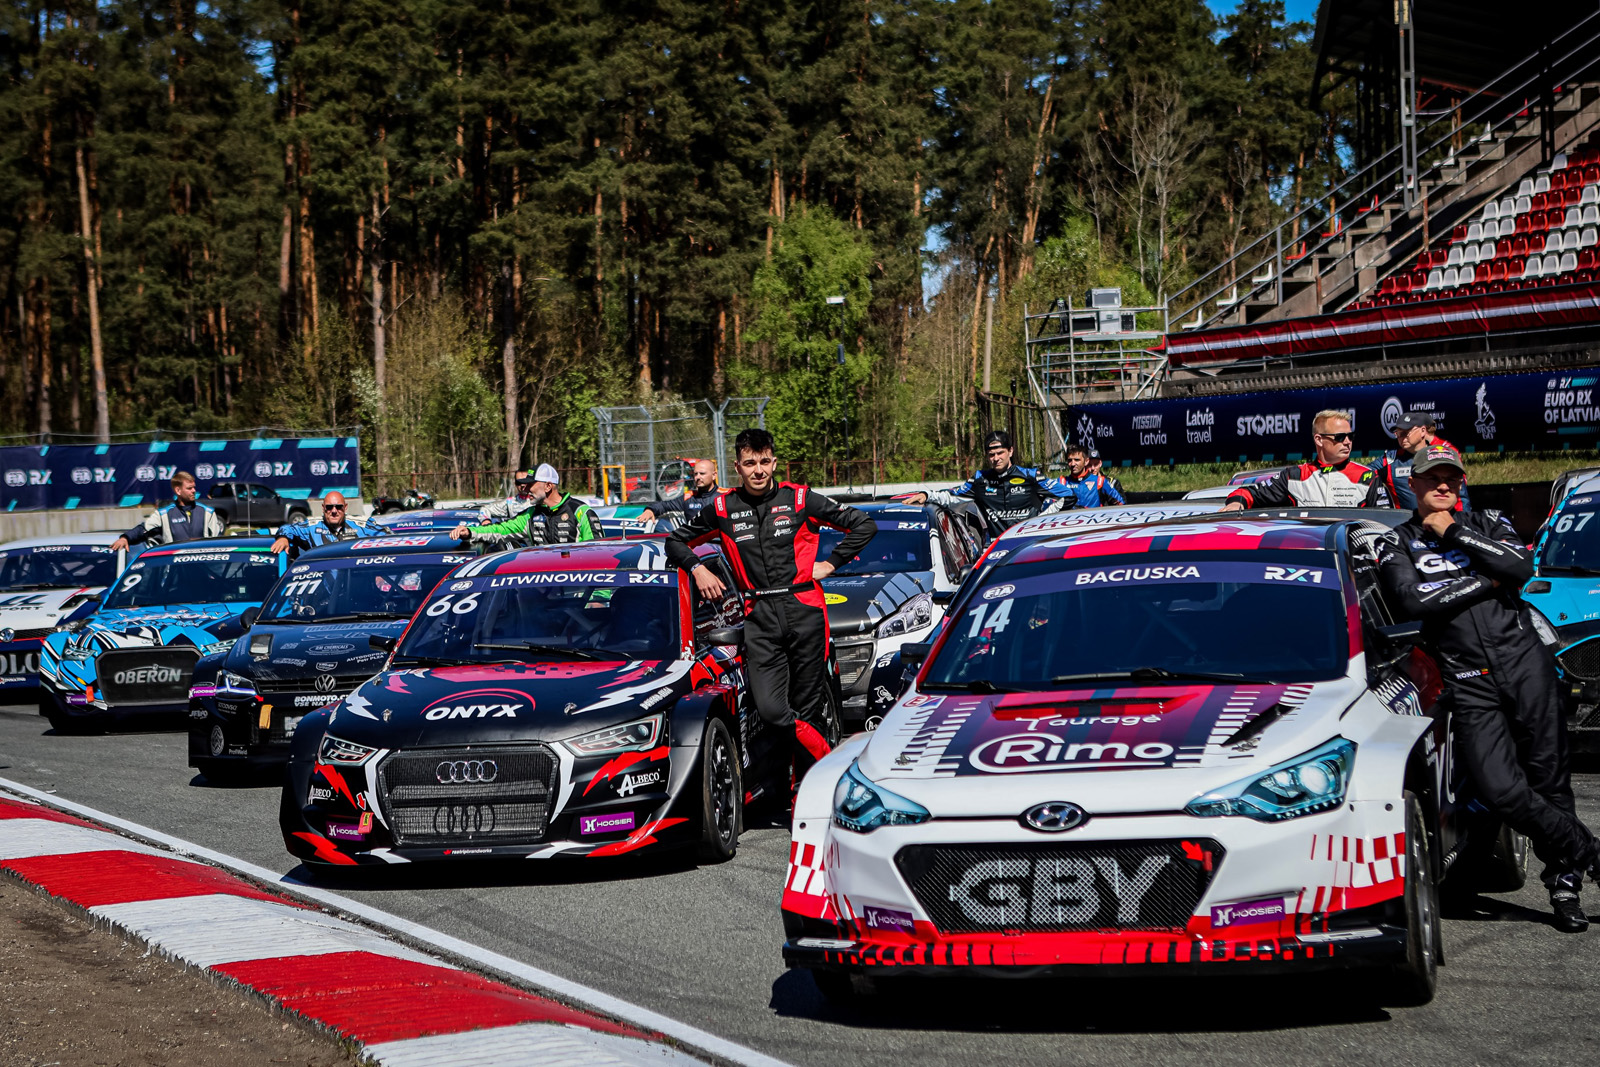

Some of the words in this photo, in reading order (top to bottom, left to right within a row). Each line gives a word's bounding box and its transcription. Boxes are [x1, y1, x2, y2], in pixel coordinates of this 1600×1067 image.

[1559, 377, 1572, 389] RX
[1544, 390, 1575, 407] EURO
[1576, 389, 1593, 405] RX
[1132, 414, 1162, 430] MISSION
[1186, 407, 1214, 427] Latvia
[1544, 408, 1559, 424] OF
[1560, 406, 1600, 423] LATVIA
[1236, 413, 1301, 437] STORENT
[1140, 430, 1167, 446] Latvia
[1186, 426, 1212, 443] travel
[93, 467, 117, 483] RX
[157, 464, 177, 481] RX
[215, 463, 237, 478] RX
[273, 461, 294, 477] RX
[330, 460, 350, 475] RX
[29, 469, 53, 485] RX
[396, 520, 434, 528] PAILLER
[897, 521, 928, 530] RX1
[1554, 511, 1596, 534] 67
[32, 545, 71, 554] LARSEN
[173, 553, 231, 564] KONCSEG
[249, 554, 276, 564] RX1
[355, 556, 396, 566] FUČÍK
[490, 573, 617, 588] LITWINOWICZ
[628, 573, 669, 585] RX1
[1075, 565, 1201, 585] BACIUSKA
[1263, 566, 1323, 583] RX1
[120, 574, 143, 592] 9
[284, 579, 323, 597] 111
[426, 592, 482, 617] 66
[967, 598, 1014, 639] 14
[114, 668, 182, 684] OBERON
[1454, 670, 1482, 680] ROKAS
[424, 703, 525, 721] ONYX
[1014, 714, 1162, 731] Tauragė
[991, 738, 1174, 766] Rimo
[616, 771, 661, 798] ALBECO
[307, 784, 332, 806] ALBECO
[595, 817, 633, 829] HOOSIER
[949, 855, 1170, 925] GBY
[1231, 905, 1283, 919] HOOSIER
[877, 915, 914, 928] HOOSIER
